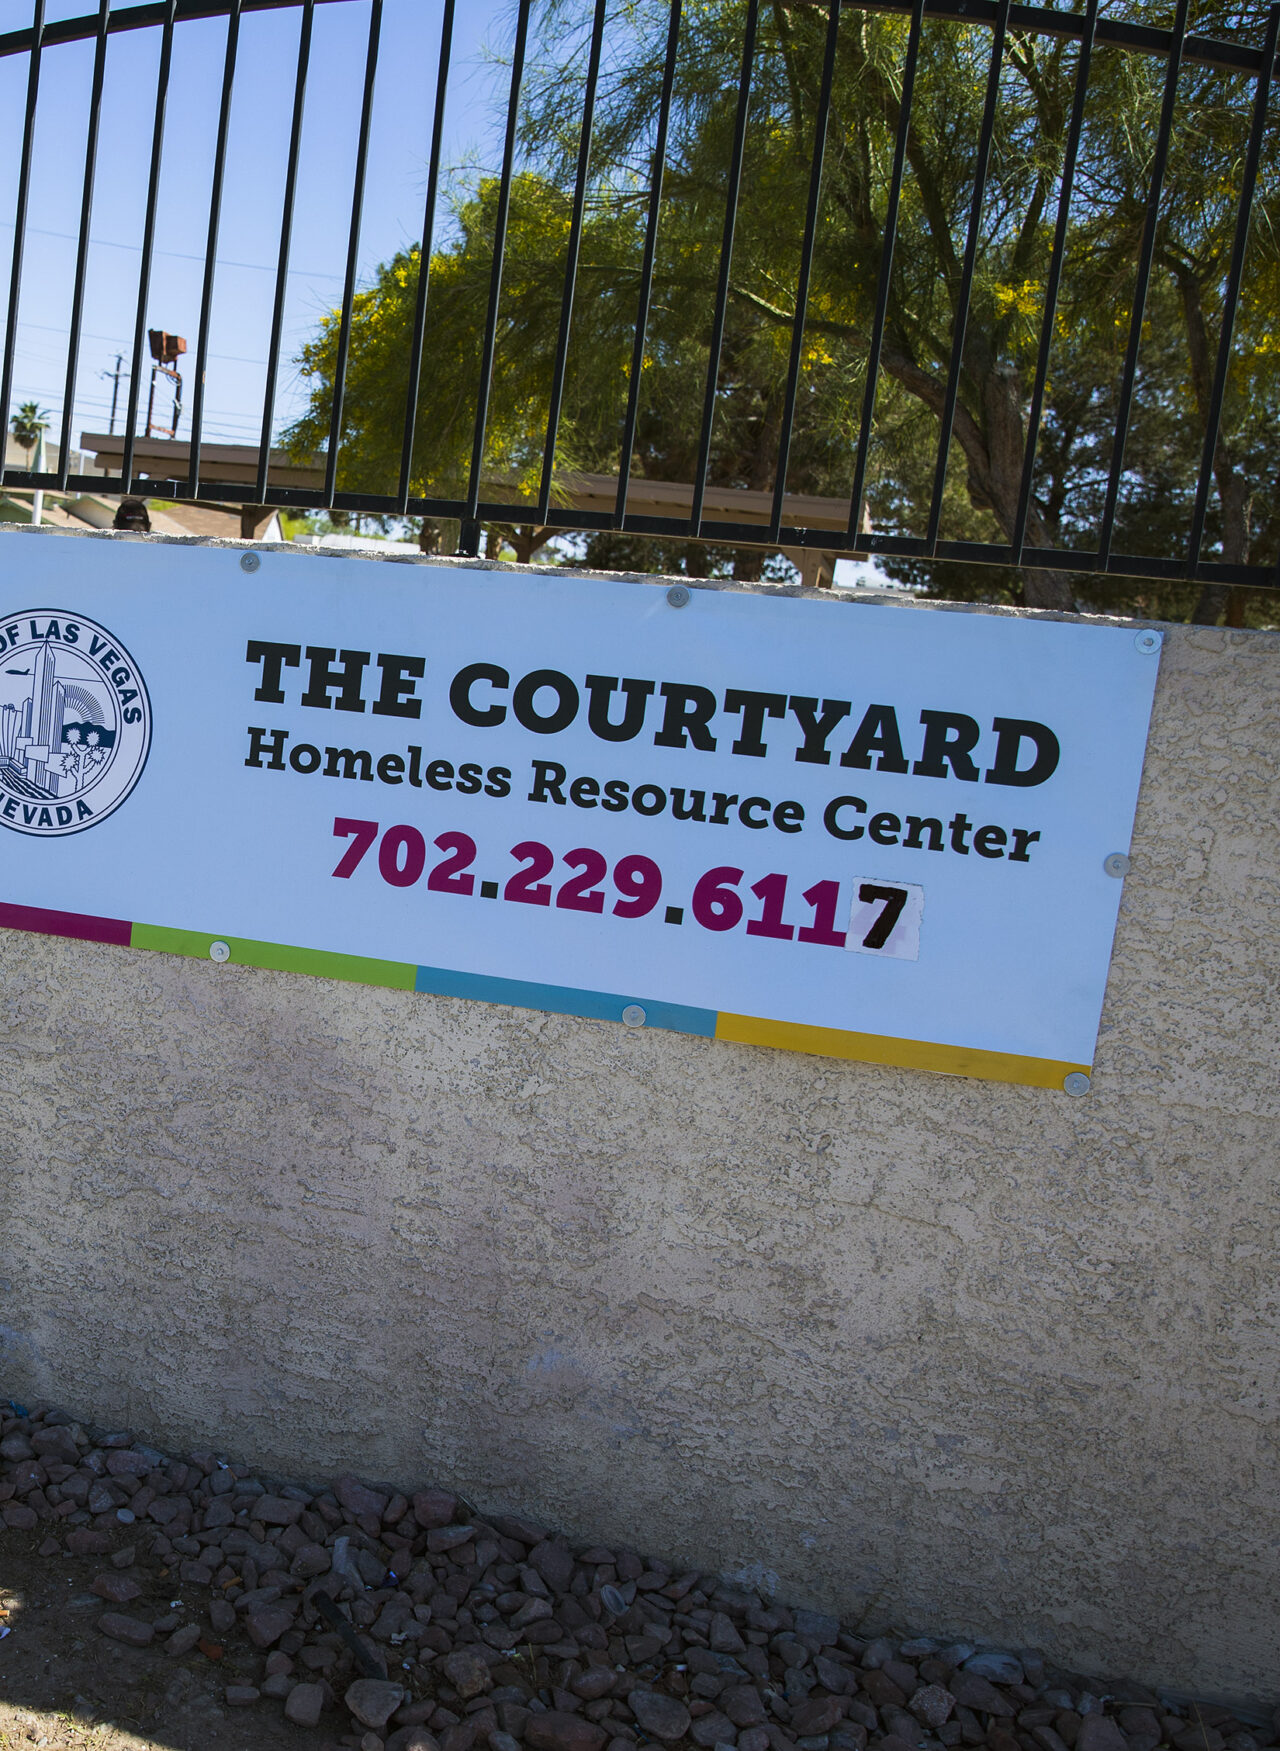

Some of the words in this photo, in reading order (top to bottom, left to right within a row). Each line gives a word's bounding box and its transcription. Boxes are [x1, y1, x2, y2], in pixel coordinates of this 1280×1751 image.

[30, 619, 80, 644] LAS
[88, 634, 143, 725] VEGAS
[246, 639, 426, 719] THE
[449, 662, 1060, 788] COURTYARD
[244, 726, 512, 798] Homeless
[527, 759, 805, 834] Resource
[823, 795, 1041, 863] Center
[331, 816, 908, 950] 702.229.6117
